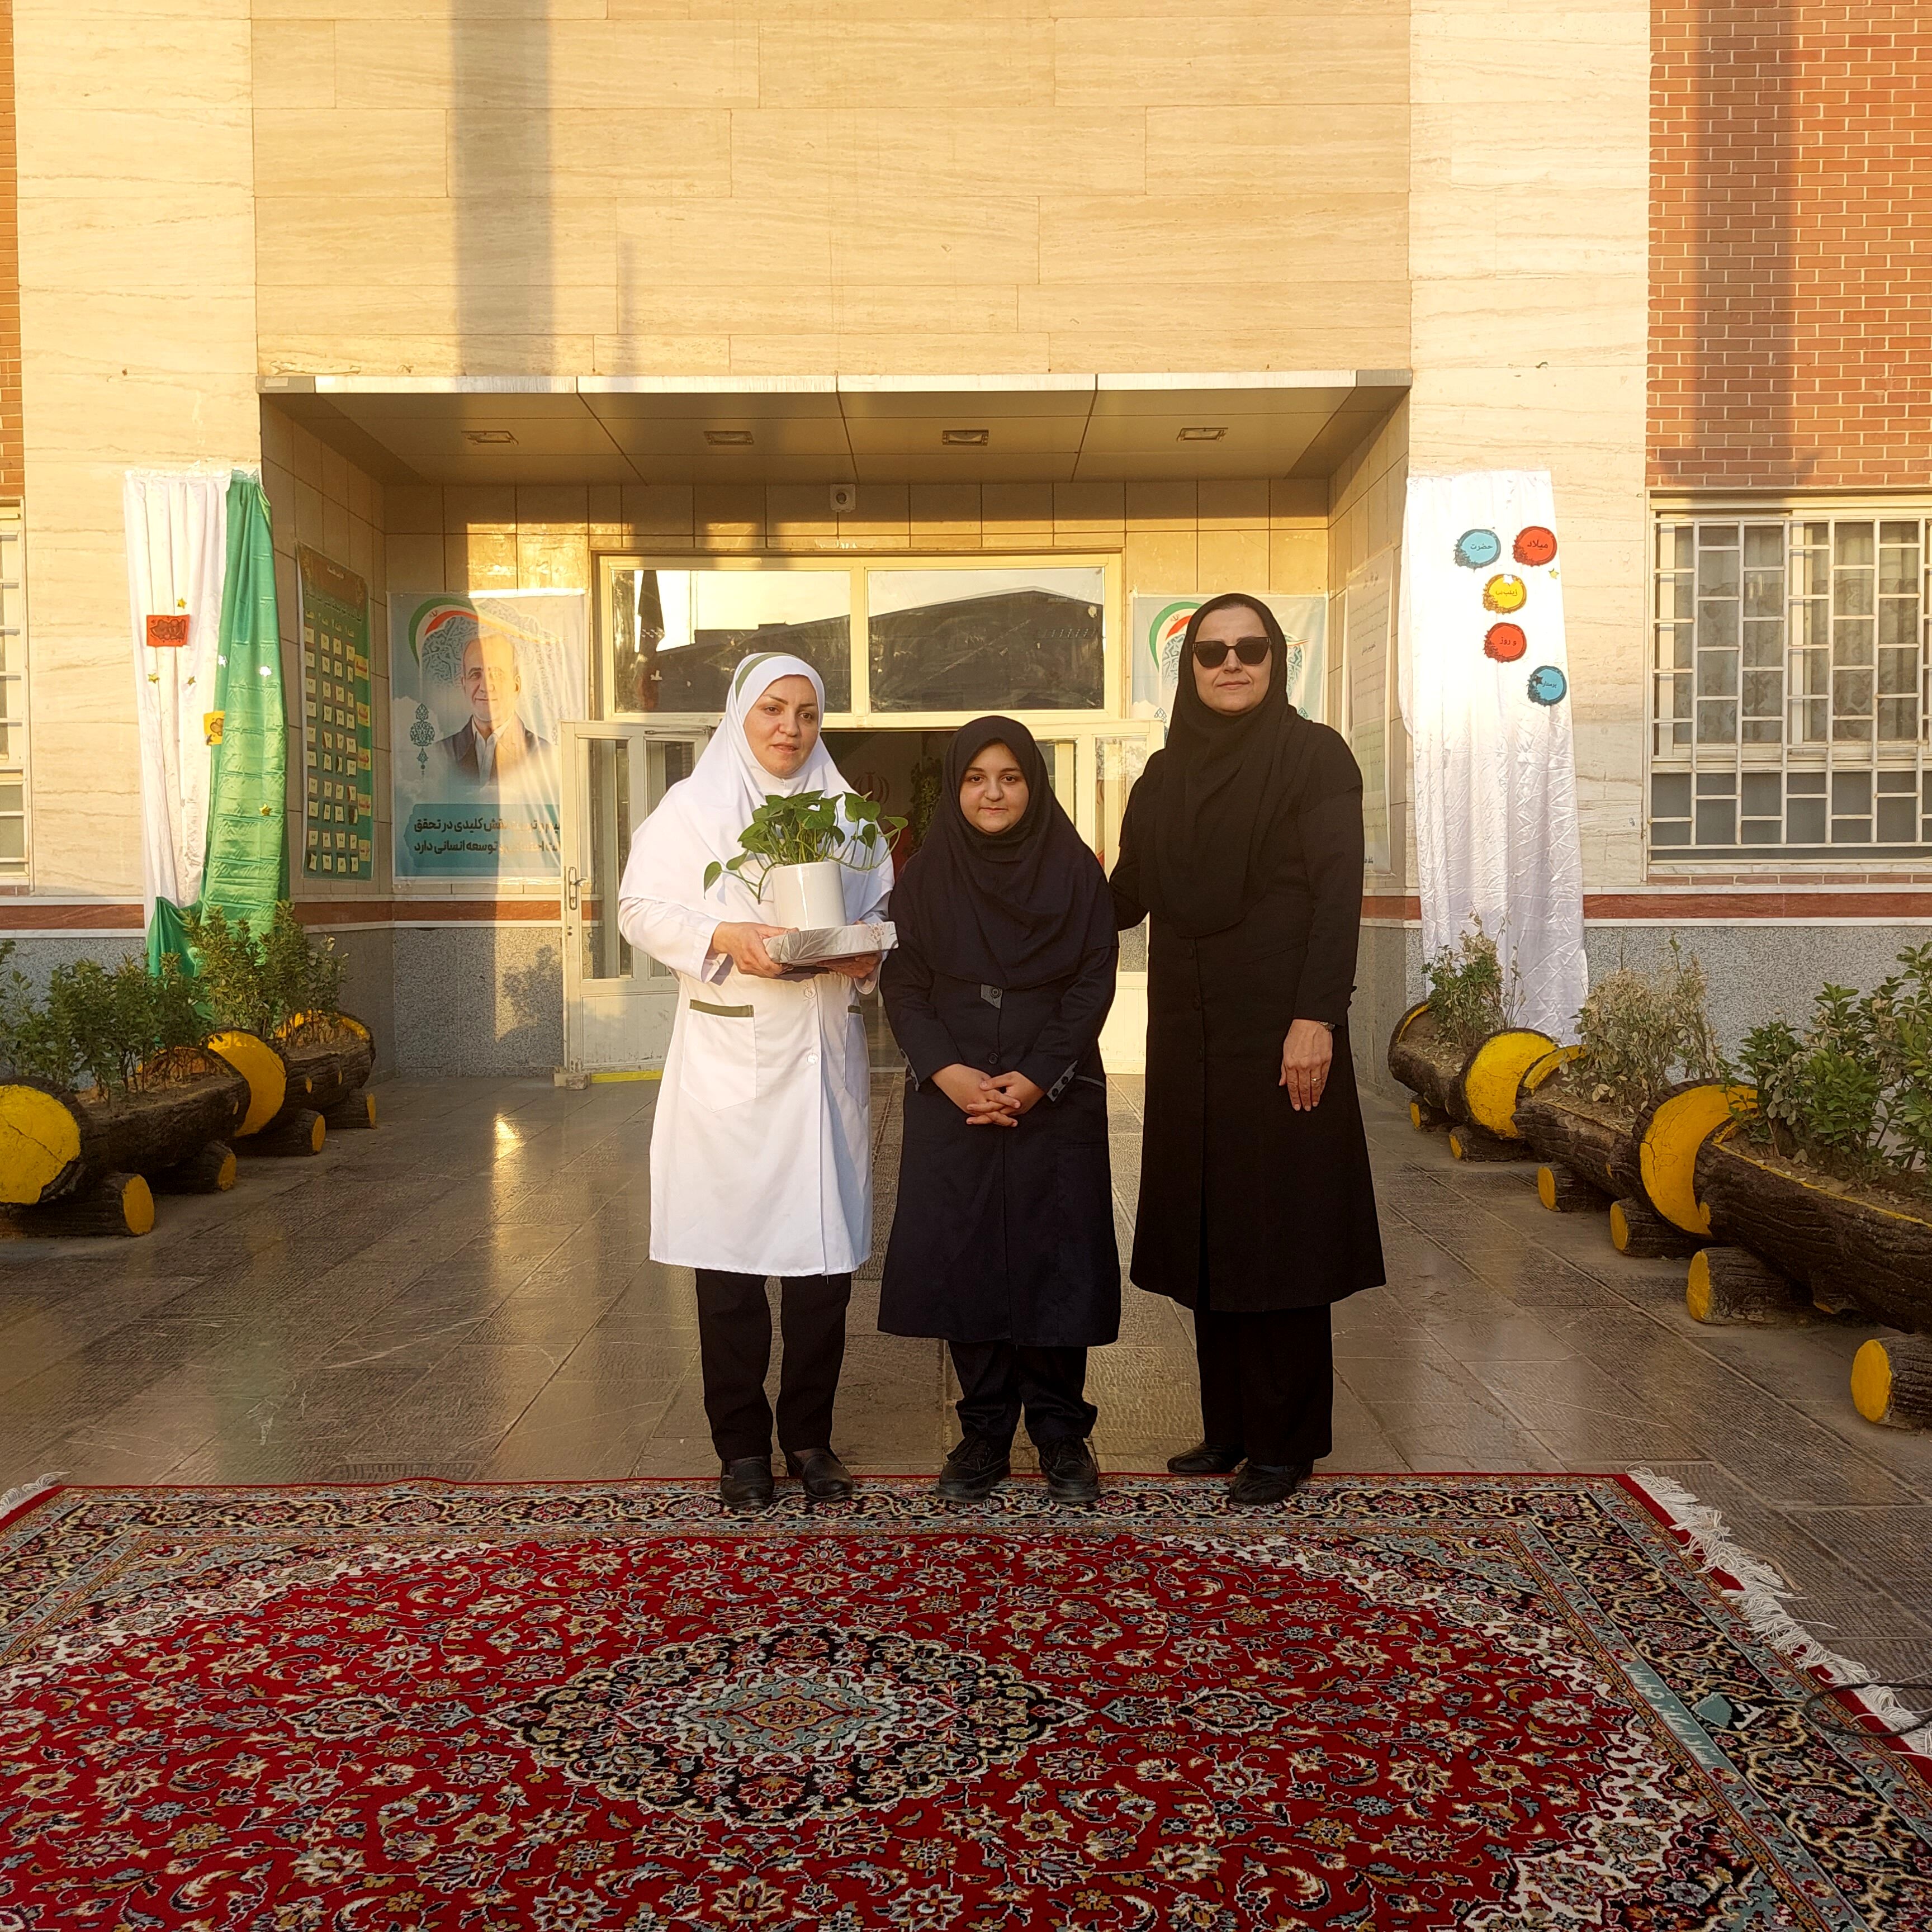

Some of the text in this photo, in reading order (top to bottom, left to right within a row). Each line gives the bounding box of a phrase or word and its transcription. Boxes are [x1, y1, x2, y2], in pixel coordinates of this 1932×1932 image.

[1527, 539, 1548, 550] میلاد
[414, 818, 441, 832] تحقق
[442, 821, 453, 832] در
[454, 817, 484, 833] کلیدی
[414, 840, 433, 854] دارد
[434, 840, 465, 854] انسانی
[466, 841, 499, 854] توسعه
